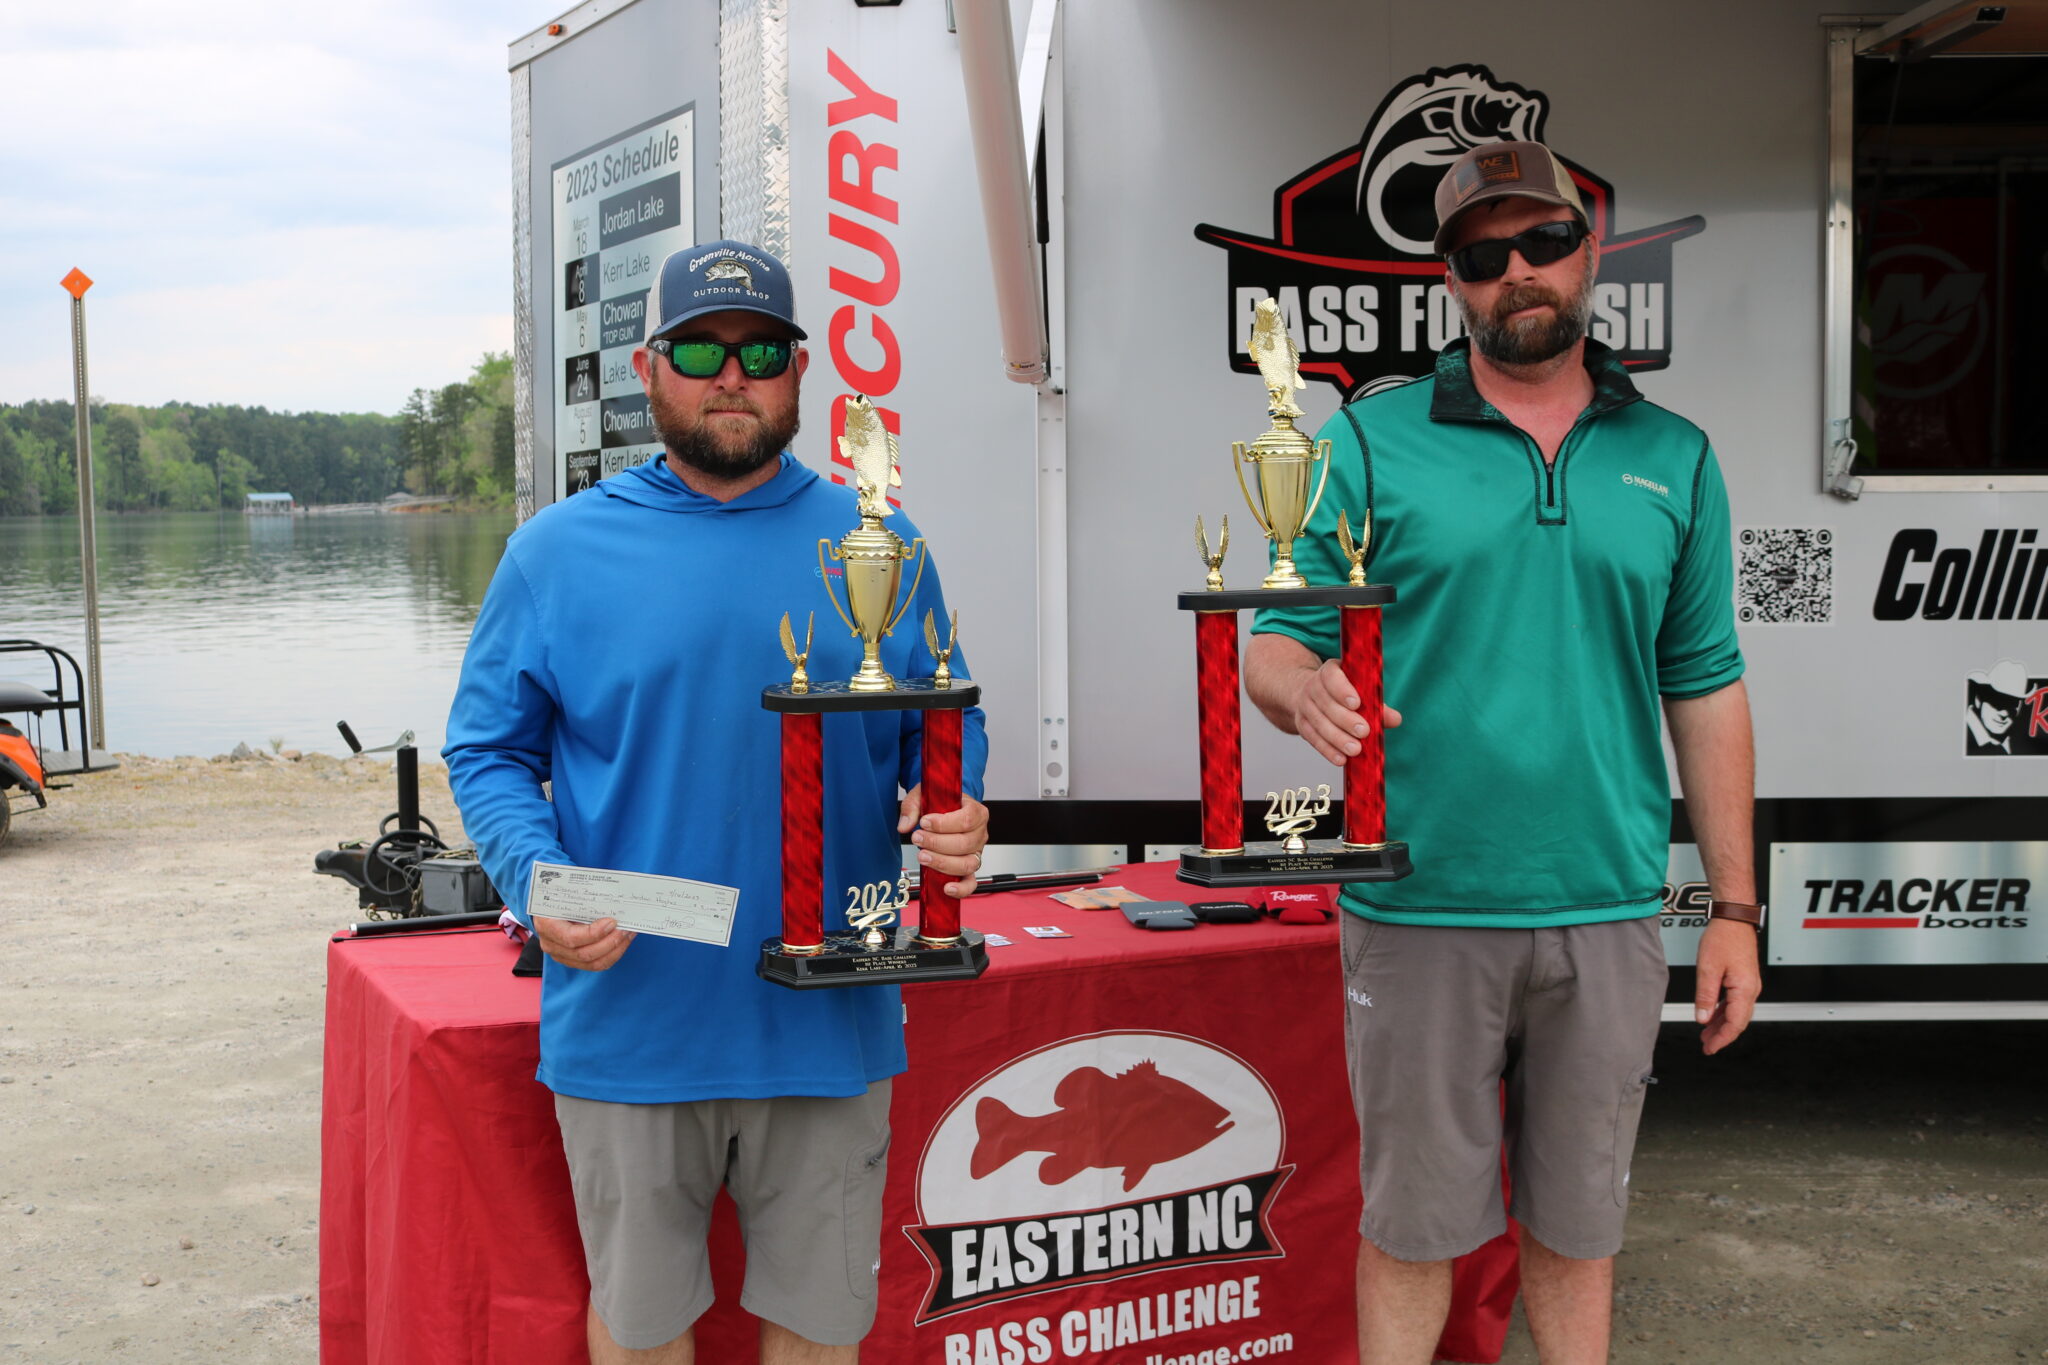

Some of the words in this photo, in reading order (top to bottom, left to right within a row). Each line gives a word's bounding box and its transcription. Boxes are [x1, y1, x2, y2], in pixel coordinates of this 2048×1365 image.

[566, 160, 598, 204] 2023
[602, 129, 679, 188] Schedule
[602, 207, 635, 236] Jordan
[638, 195, 664, 222] Lake
[576, 231, 588, 257] 18
[603, 262, 624, 285] Kerr
[626, 252, 650, 278] Lake
[689, 248, 736, 272] Greenville
[735, 250, 771, 272] Marine
[578, 280, 586, 303] 8
[693, 287, 741, 298] OUTDOOR
[746, 289, 770, 301] SHOP
[603, 299, 644, 326] Chowan
[1400, 284, 1468, 352] FO
[579, 325, 586, 348] 6
[576, 358, 590, 372] June
[603, 362, 627, 385] Lake
[576, 373, 589, 397] 24
[579, 422, 586, 444] 5
[603, 410, 644, 433] Chowan
[568, 453, 599, 469] September
[604, 452, 625, 473] Kerr
[577, 470, 590, 493] 23
[1264, 783, 1332, 821] 2023
[845, 878, 910, 915] 2023
[1270, 889, 1319, 902] Ranger
[1803, 878, 2031, 914] TRACKER
[1922, 914, 2029, 929] boats
[951, 1199, 1176, 1300] EASTERN
[1187, 1184, 1254, 1254] NC
[945, 1316, 1052, 1365] BASS
[1060, 1275, 1261, 1358] CHALLENGE
